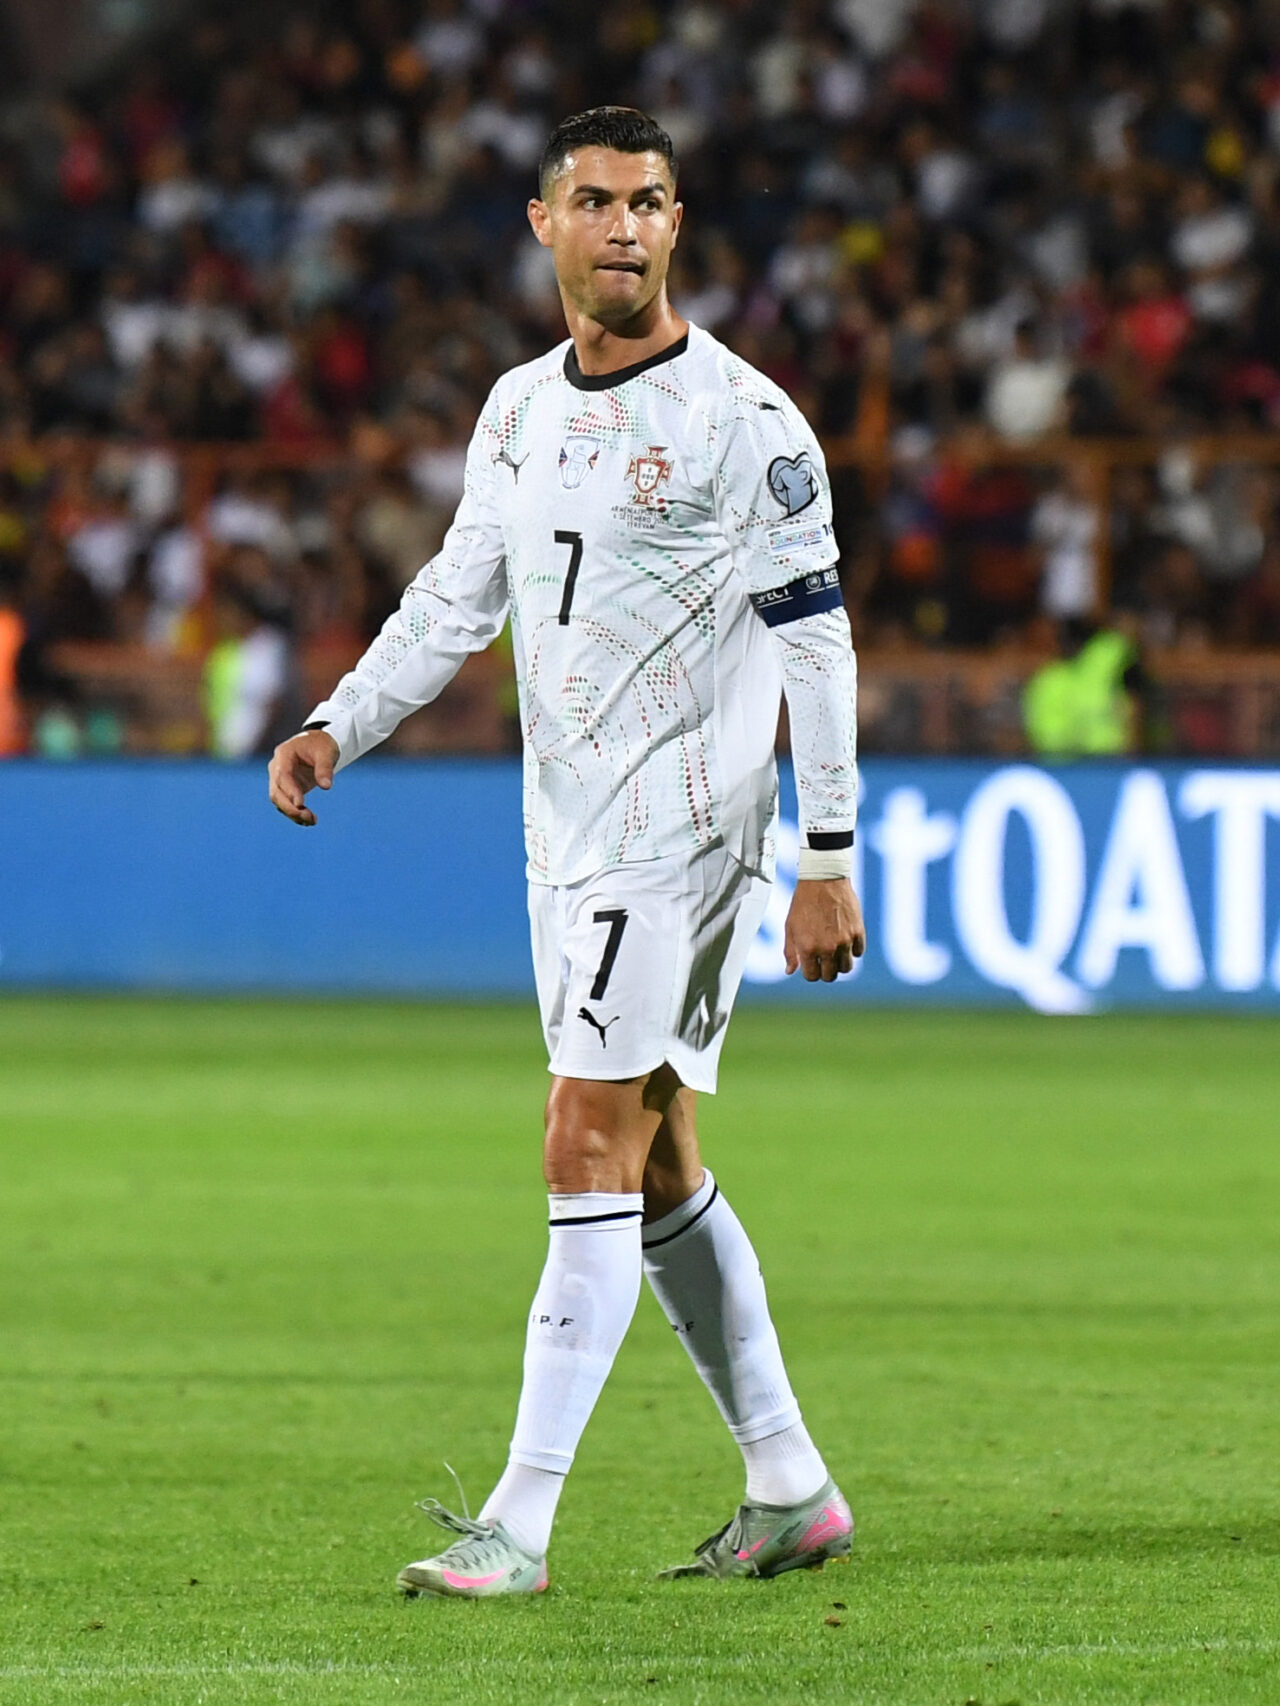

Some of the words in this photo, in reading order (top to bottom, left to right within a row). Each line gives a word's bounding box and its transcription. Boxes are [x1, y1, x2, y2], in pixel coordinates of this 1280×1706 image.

[554, 530, 583, 626] 7
[769, 530, 822, 547] FOUNDATION
[589, 908, 629, 1001] 7
